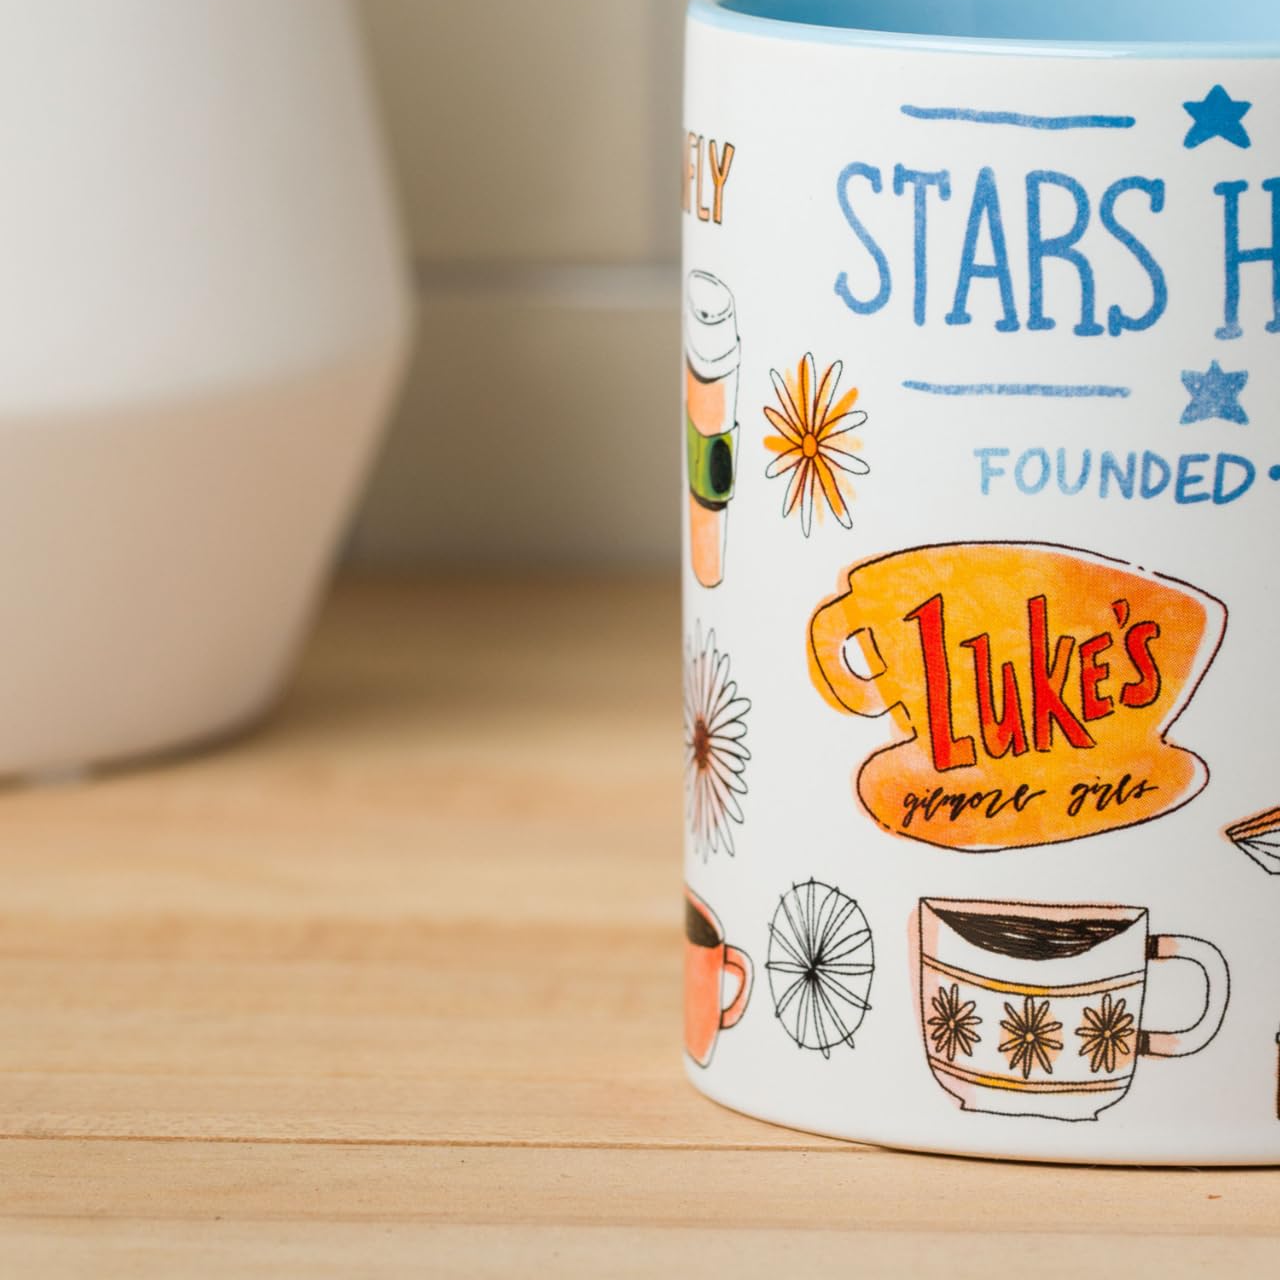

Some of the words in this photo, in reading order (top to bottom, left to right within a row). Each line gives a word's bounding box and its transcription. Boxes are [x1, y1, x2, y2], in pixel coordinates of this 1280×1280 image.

[834, 161, 1168, 337] STARS
[902, 783, 1047, 828] gilmore
[1067, 773, 1159, 817] girls
